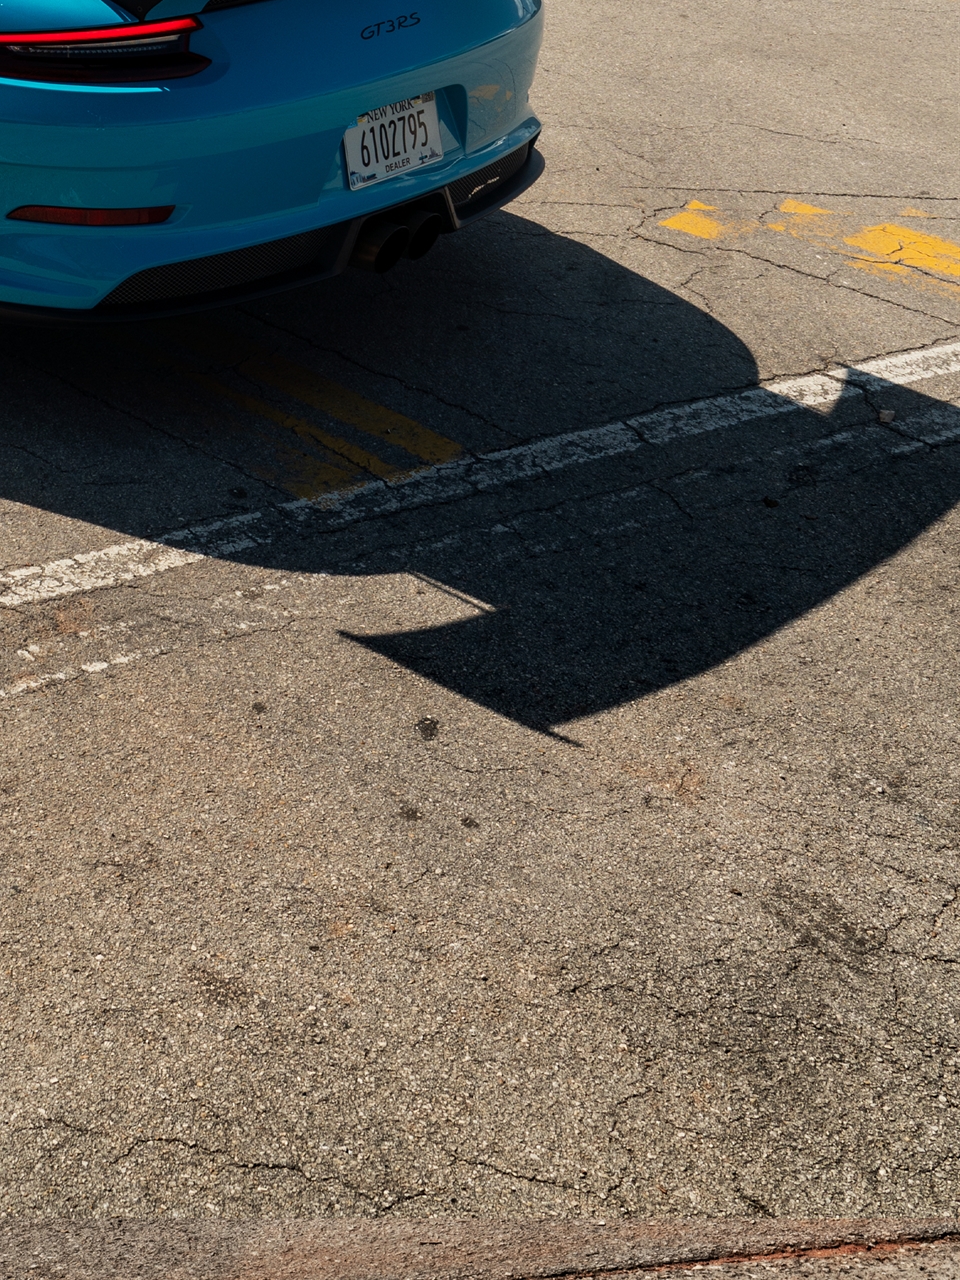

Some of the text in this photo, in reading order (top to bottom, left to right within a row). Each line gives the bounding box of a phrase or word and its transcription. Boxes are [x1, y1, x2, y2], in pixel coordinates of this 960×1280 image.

[367, 99, 414, 123] NEW YORK
[361, 109, 428, 167] 6102795
[385, 157, 411, 173] DEALER
